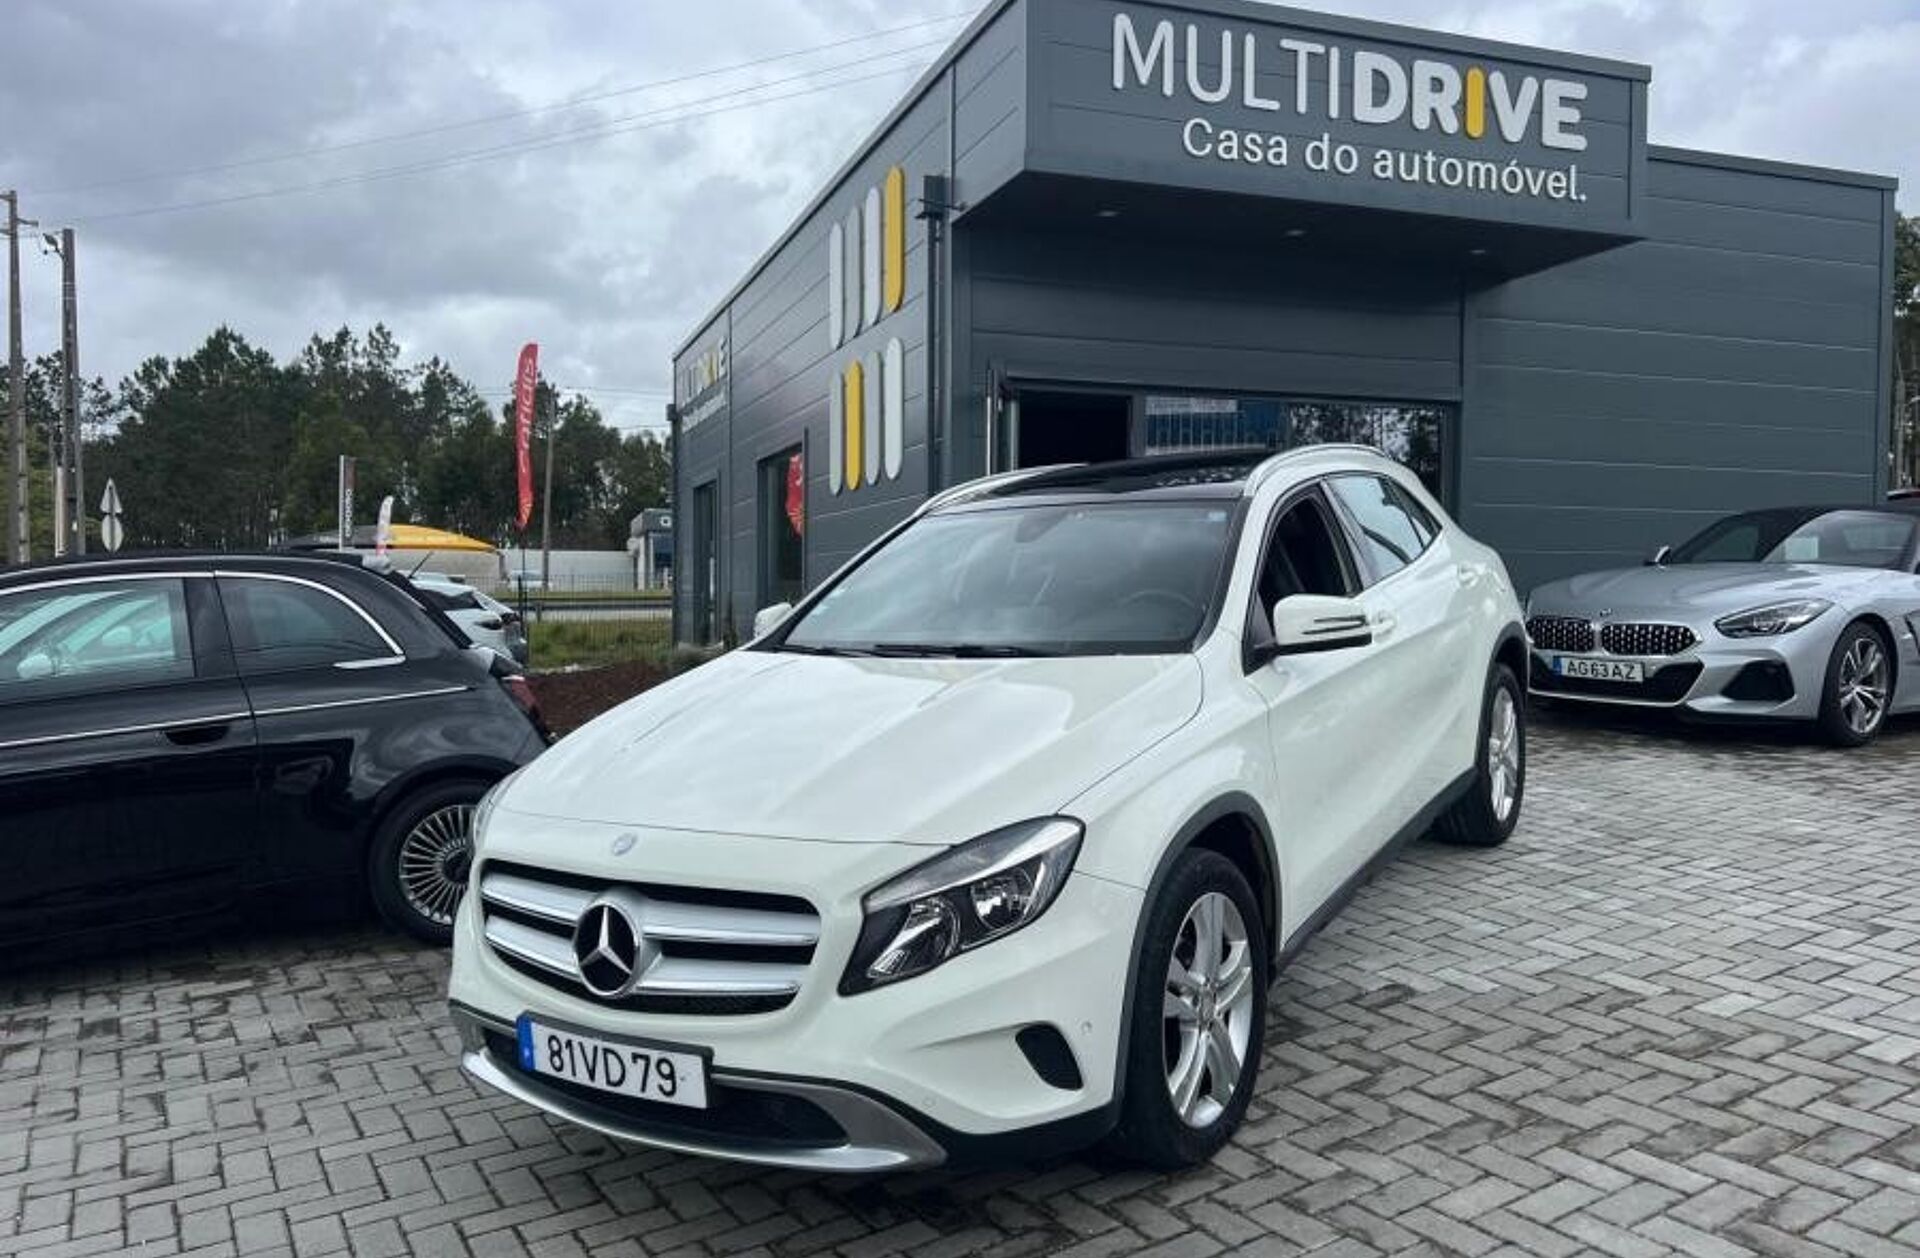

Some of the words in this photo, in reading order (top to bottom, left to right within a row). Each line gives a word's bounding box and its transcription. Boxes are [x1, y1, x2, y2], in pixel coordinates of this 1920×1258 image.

[1112, 13, 1588, 150] MULTIDRIVE
[1183, 118, 1288, 166] Casa
[1304, 133, 1358, 174] do
[1373, 149, 1587, 202] automóvel.
